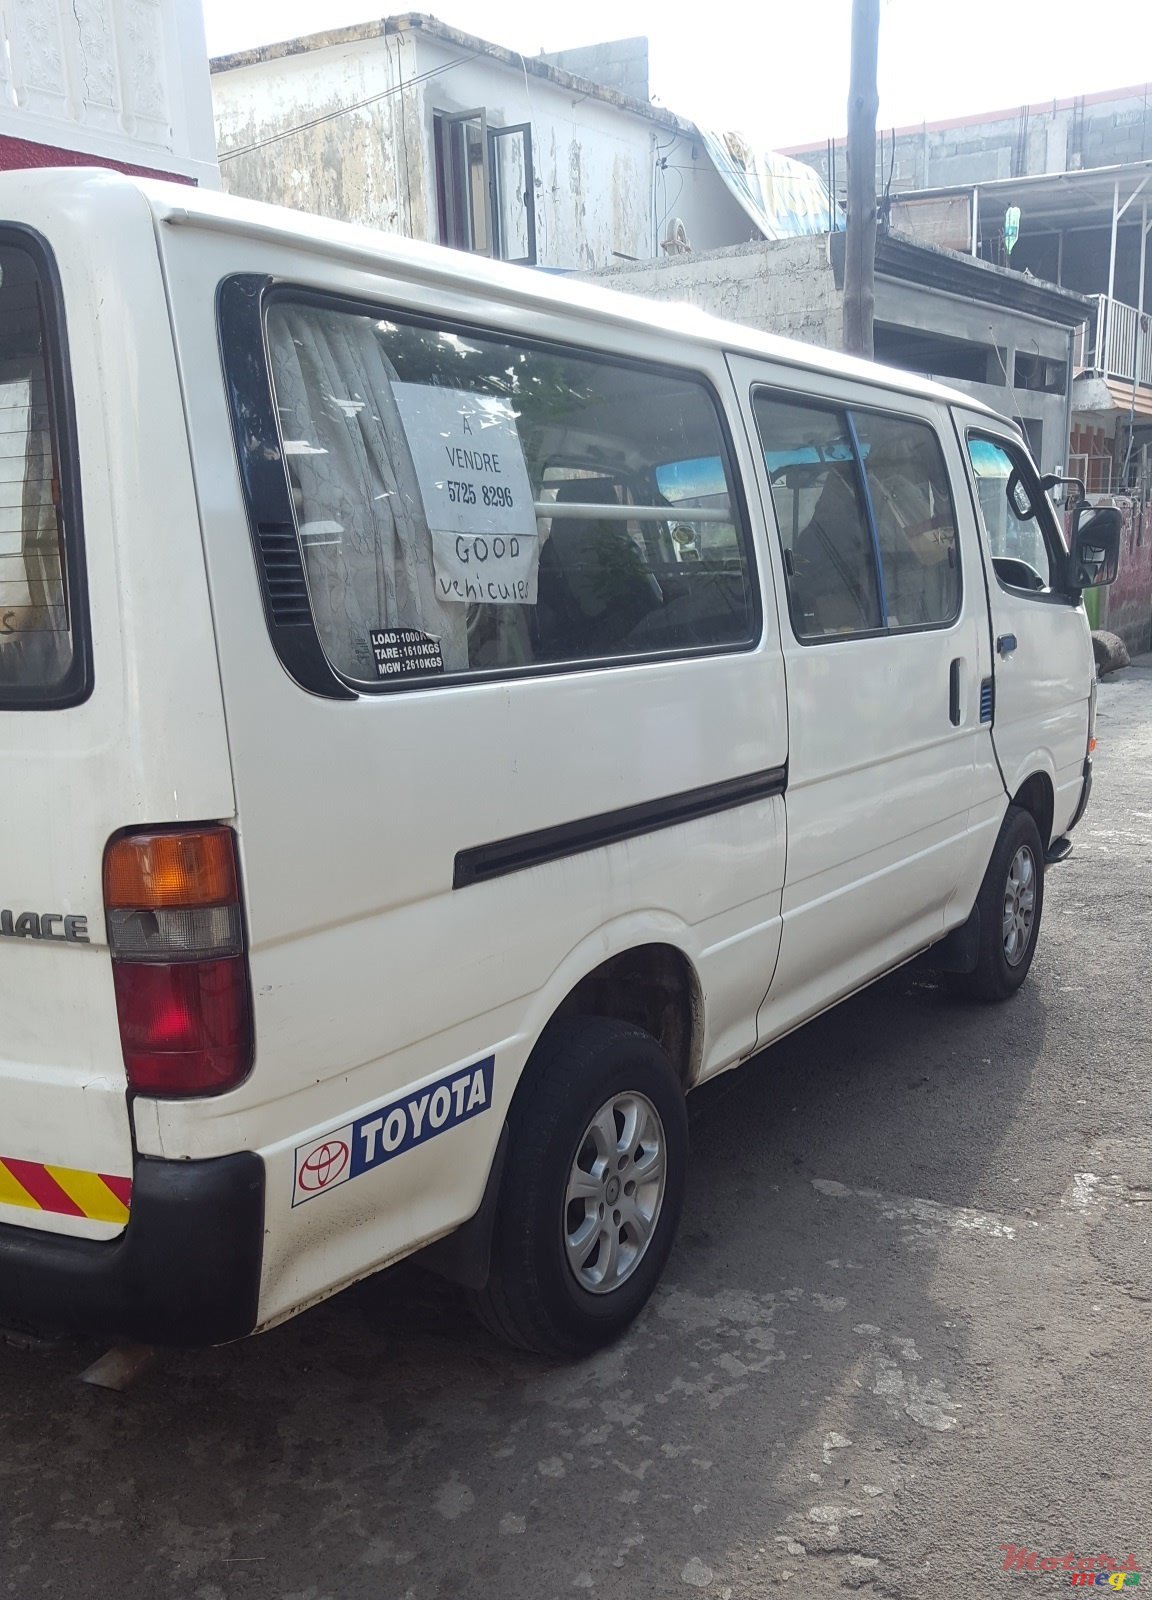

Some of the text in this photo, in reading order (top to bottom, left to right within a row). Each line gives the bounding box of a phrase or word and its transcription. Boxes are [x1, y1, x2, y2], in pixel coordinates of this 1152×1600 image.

[445, 445, 502, 474] VENDRE
[447, 480, 514, 508] 5725 8296
[455, 535, 520, 563] GOOD
[0, 908, 91, 944] IACE
[360, 1068, 487, 1164] TOYOTA
